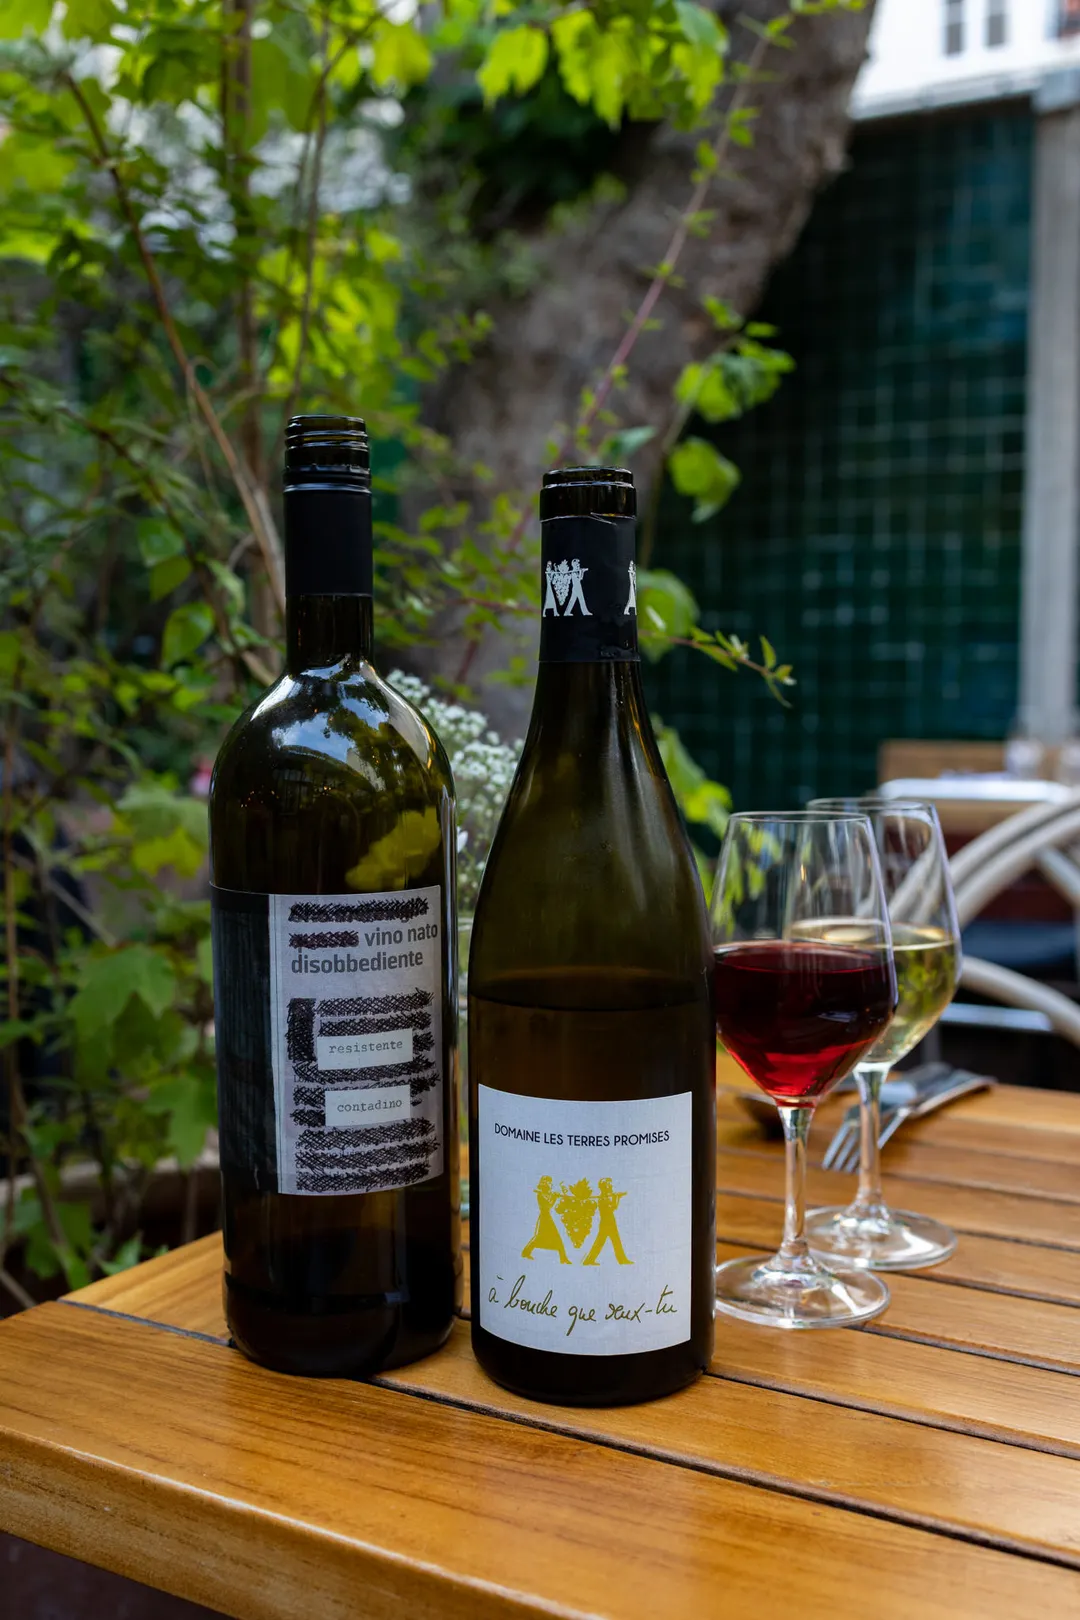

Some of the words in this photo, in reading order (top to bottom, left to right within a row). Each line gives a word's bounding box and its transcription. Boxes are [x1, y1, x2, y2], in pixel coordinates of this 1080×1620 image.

[364, 927, 403, 947] vino
[407, 922, 438, 943] nato
[291, 950, 423, 974] disobbediente
[328, 1040, 403, 1054] resistente
[336, 1098, 402, 1113] contadino
[494, 1122, 541, 1143] DOMAINE
[544, 1132, 564, 1146] LES
[567, 1134, 610, 1147] TERRES
[614, 1130, 670, 1146] PROMISES
[504, 1274, 558, 1318] bouche
[566, 1305, 597, 1337] que
